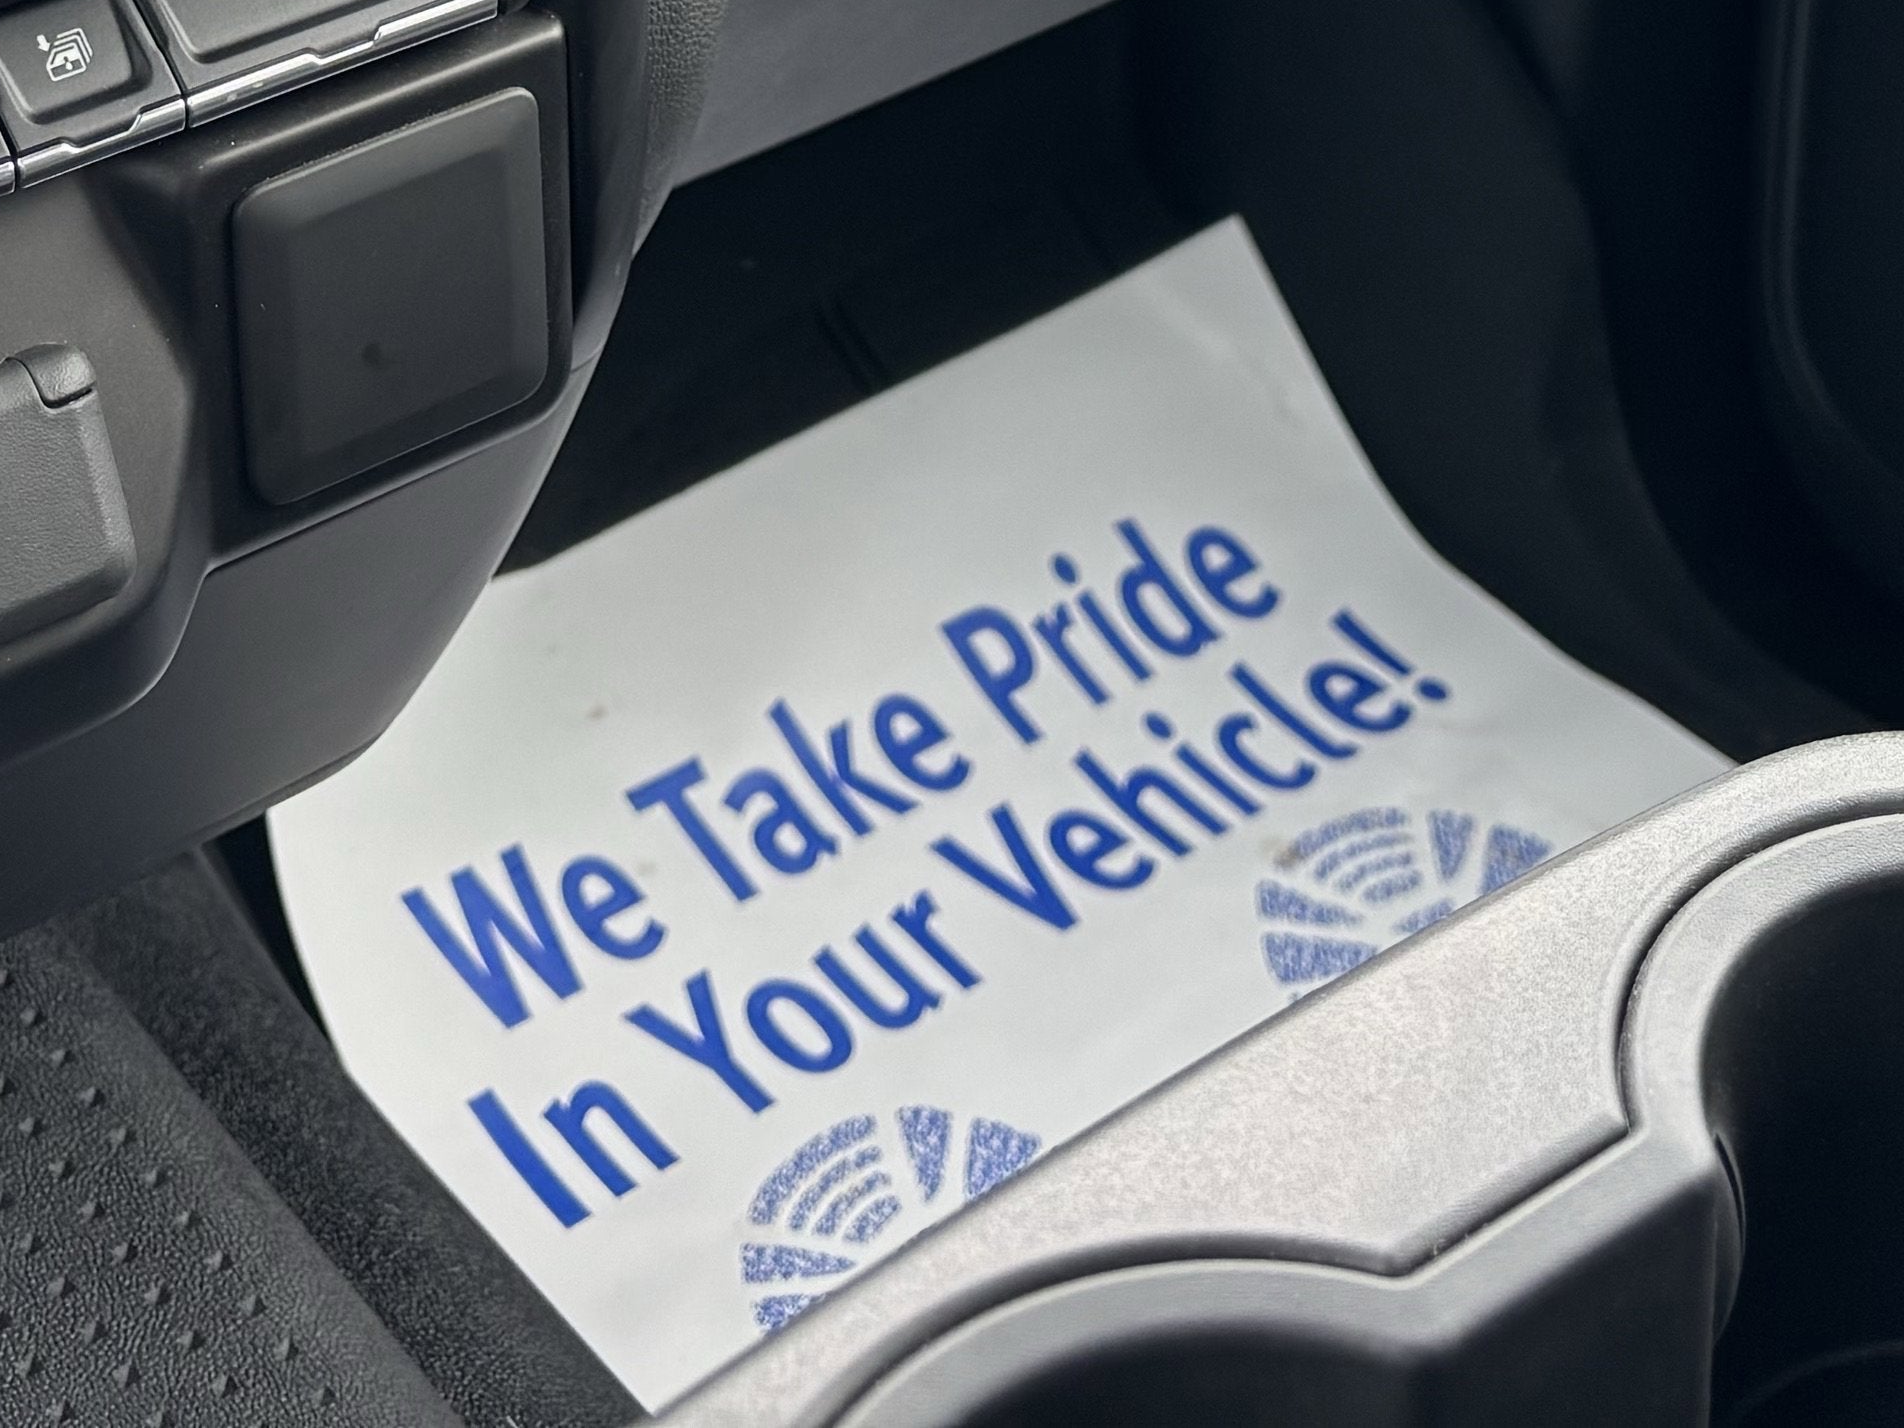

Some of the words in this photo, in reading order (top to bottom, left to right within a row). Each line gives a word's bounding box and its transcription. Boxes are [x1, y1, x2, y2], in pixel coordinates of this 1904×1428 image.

[400, 844, 667, 1031] We
[626, 698, 973, 904] Take
[941, 516, 1284, 747] Pride
[466, 1076, 681, 1230] In
[622, 889, 982, 1115] Your
[928, 608, 1454, 935] Vehicle!
